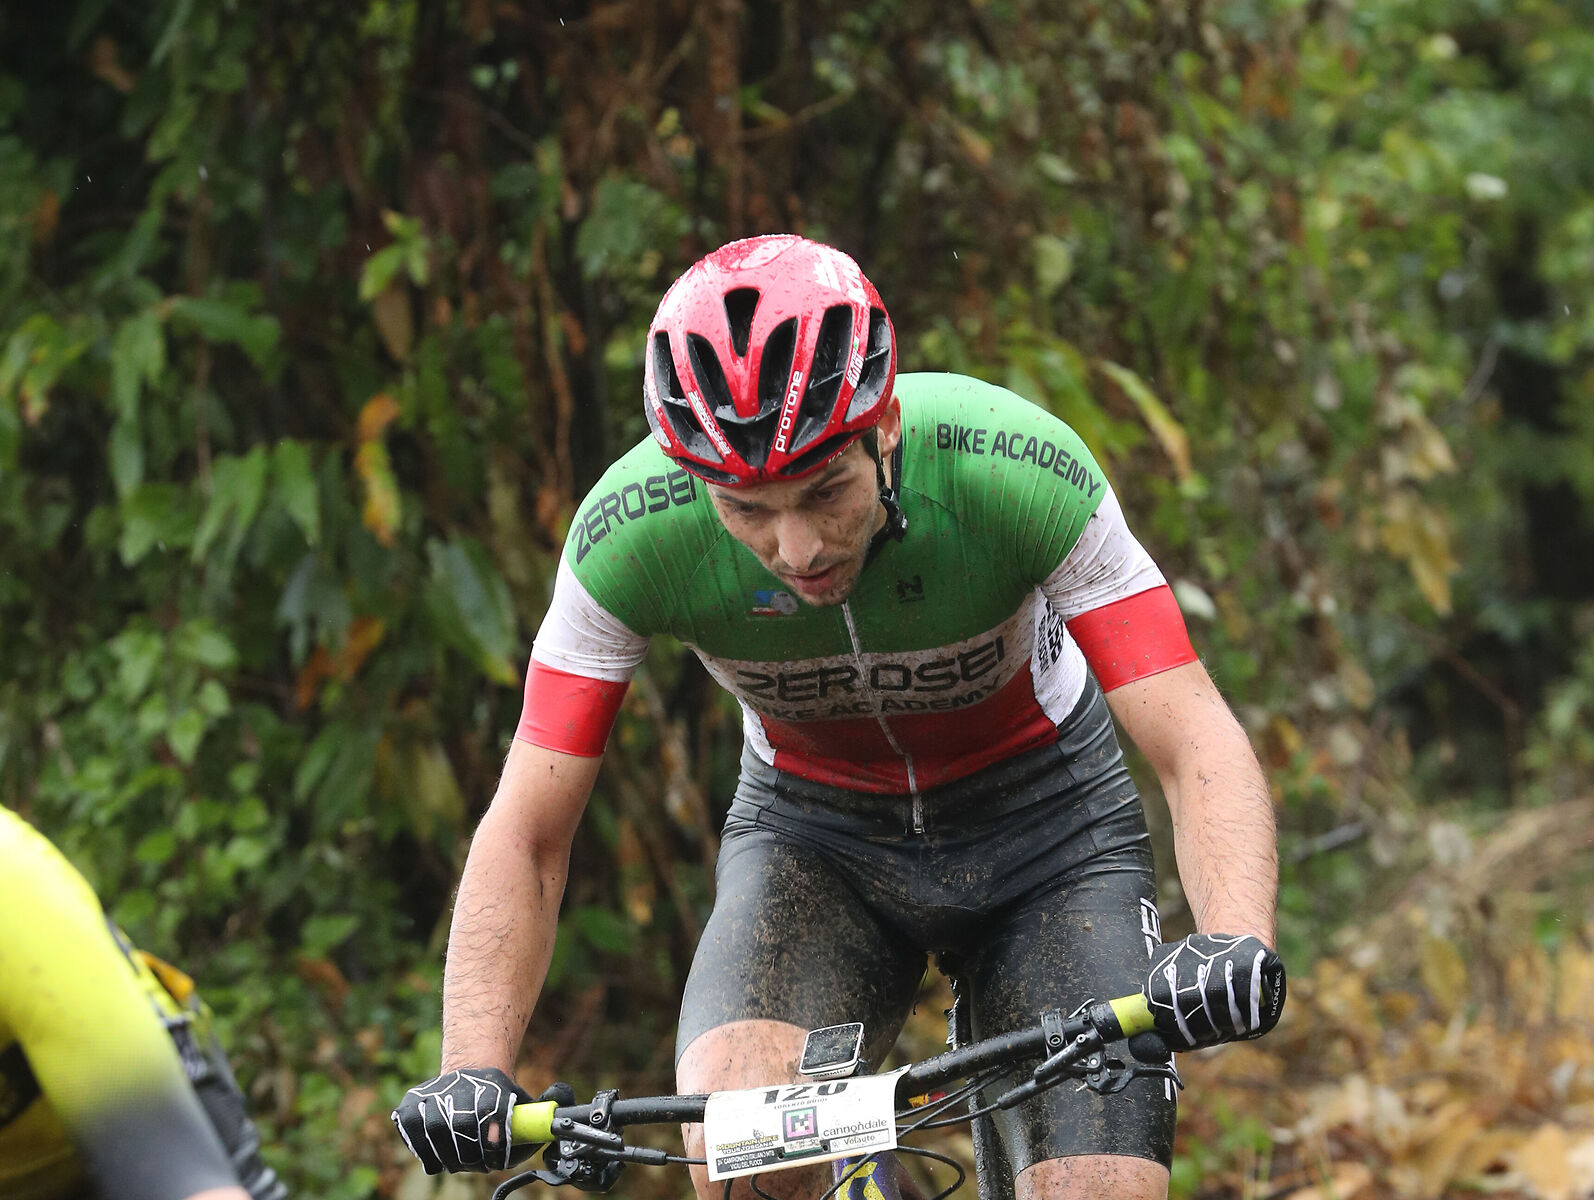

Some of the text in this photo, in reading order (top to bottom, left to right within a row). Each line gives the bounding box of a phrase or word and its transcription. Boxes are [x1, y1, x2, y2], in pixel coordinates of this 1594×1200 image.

[774, 370, 803, 454] protone
[936, 423, 1101, 498] BIKE ACADEMY
[571, 468, 697, 565] ZEROSEI
[736, 635, 1005, 701] ZEROSEI
[822, 1119, 888, 1137] cannondale
